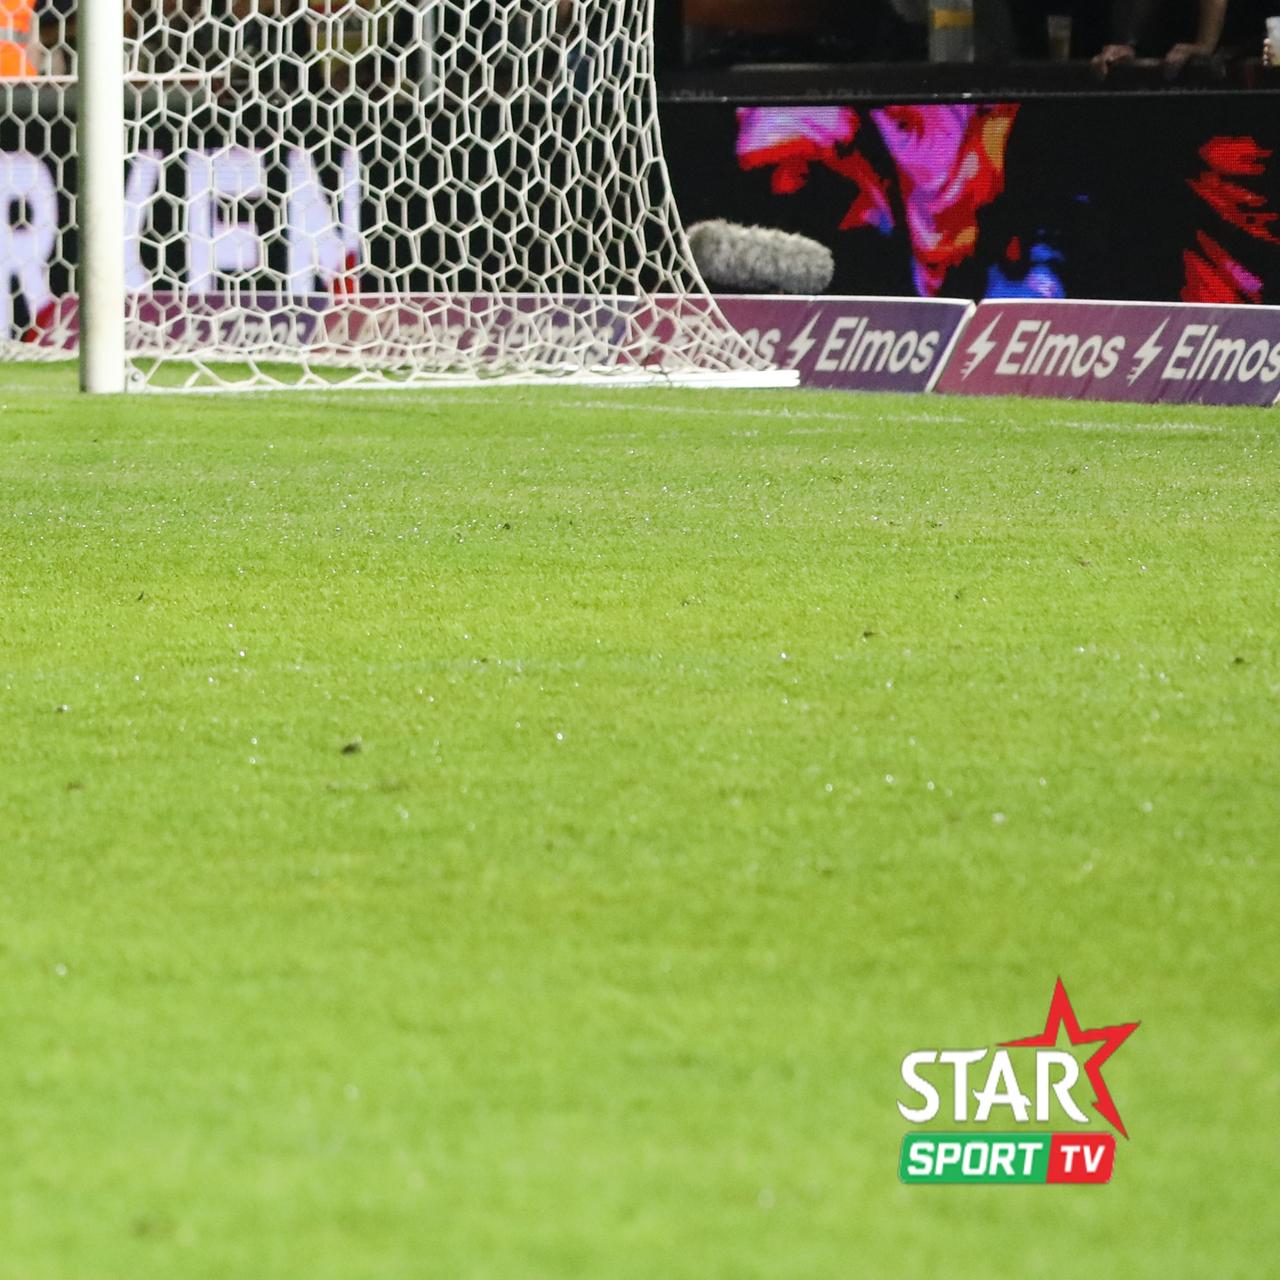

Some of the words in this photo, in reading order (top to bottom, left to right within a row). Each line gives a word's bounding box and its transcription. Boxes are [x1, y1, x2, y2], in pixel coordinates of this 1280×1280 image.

[815, 316, 940, 374] Elmos
[995, 320, 1126, 377] Elmos
[1161, 323, 1280, 383] Elmos
